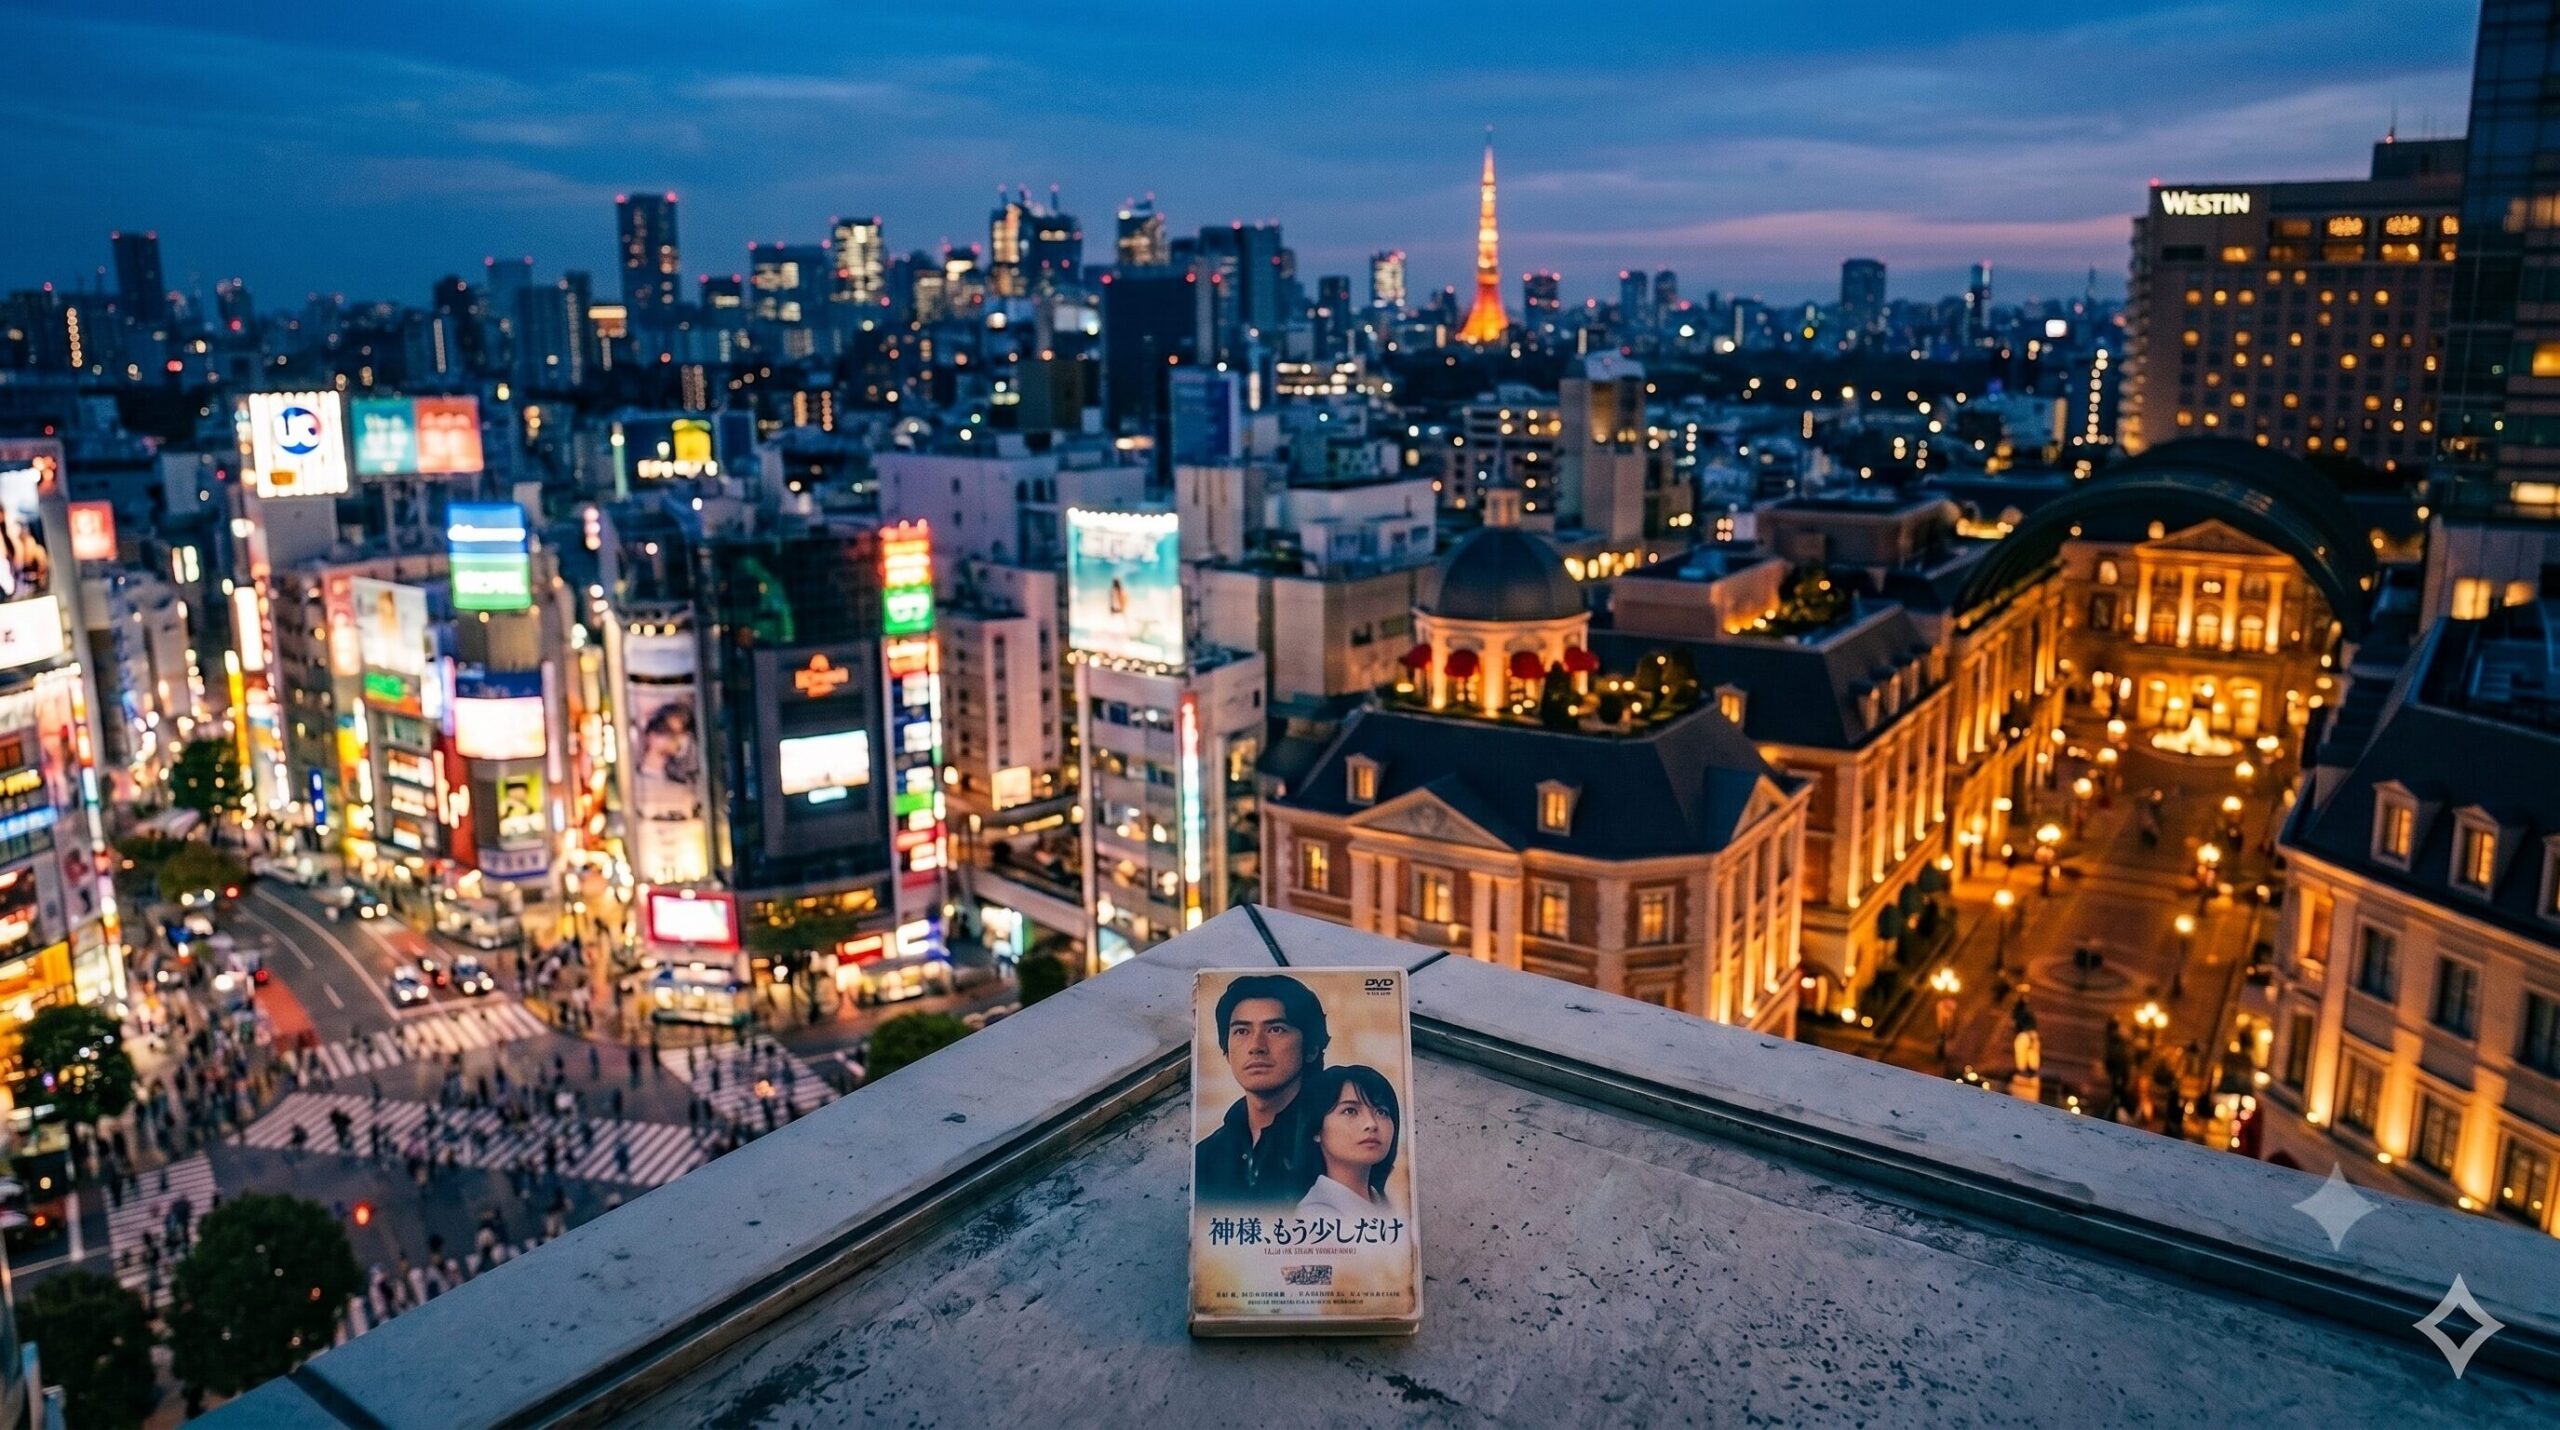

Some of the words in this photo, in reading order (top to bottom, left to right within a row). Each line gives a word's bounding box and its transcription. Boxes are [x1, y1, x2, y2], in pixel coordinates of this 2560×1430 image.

[2161, 190, 2250, 215] WESTIN
[1365, 978, 1393, 987] DVD
[1208, 1217, 1404, 1246] 神様、もう少しだけ
